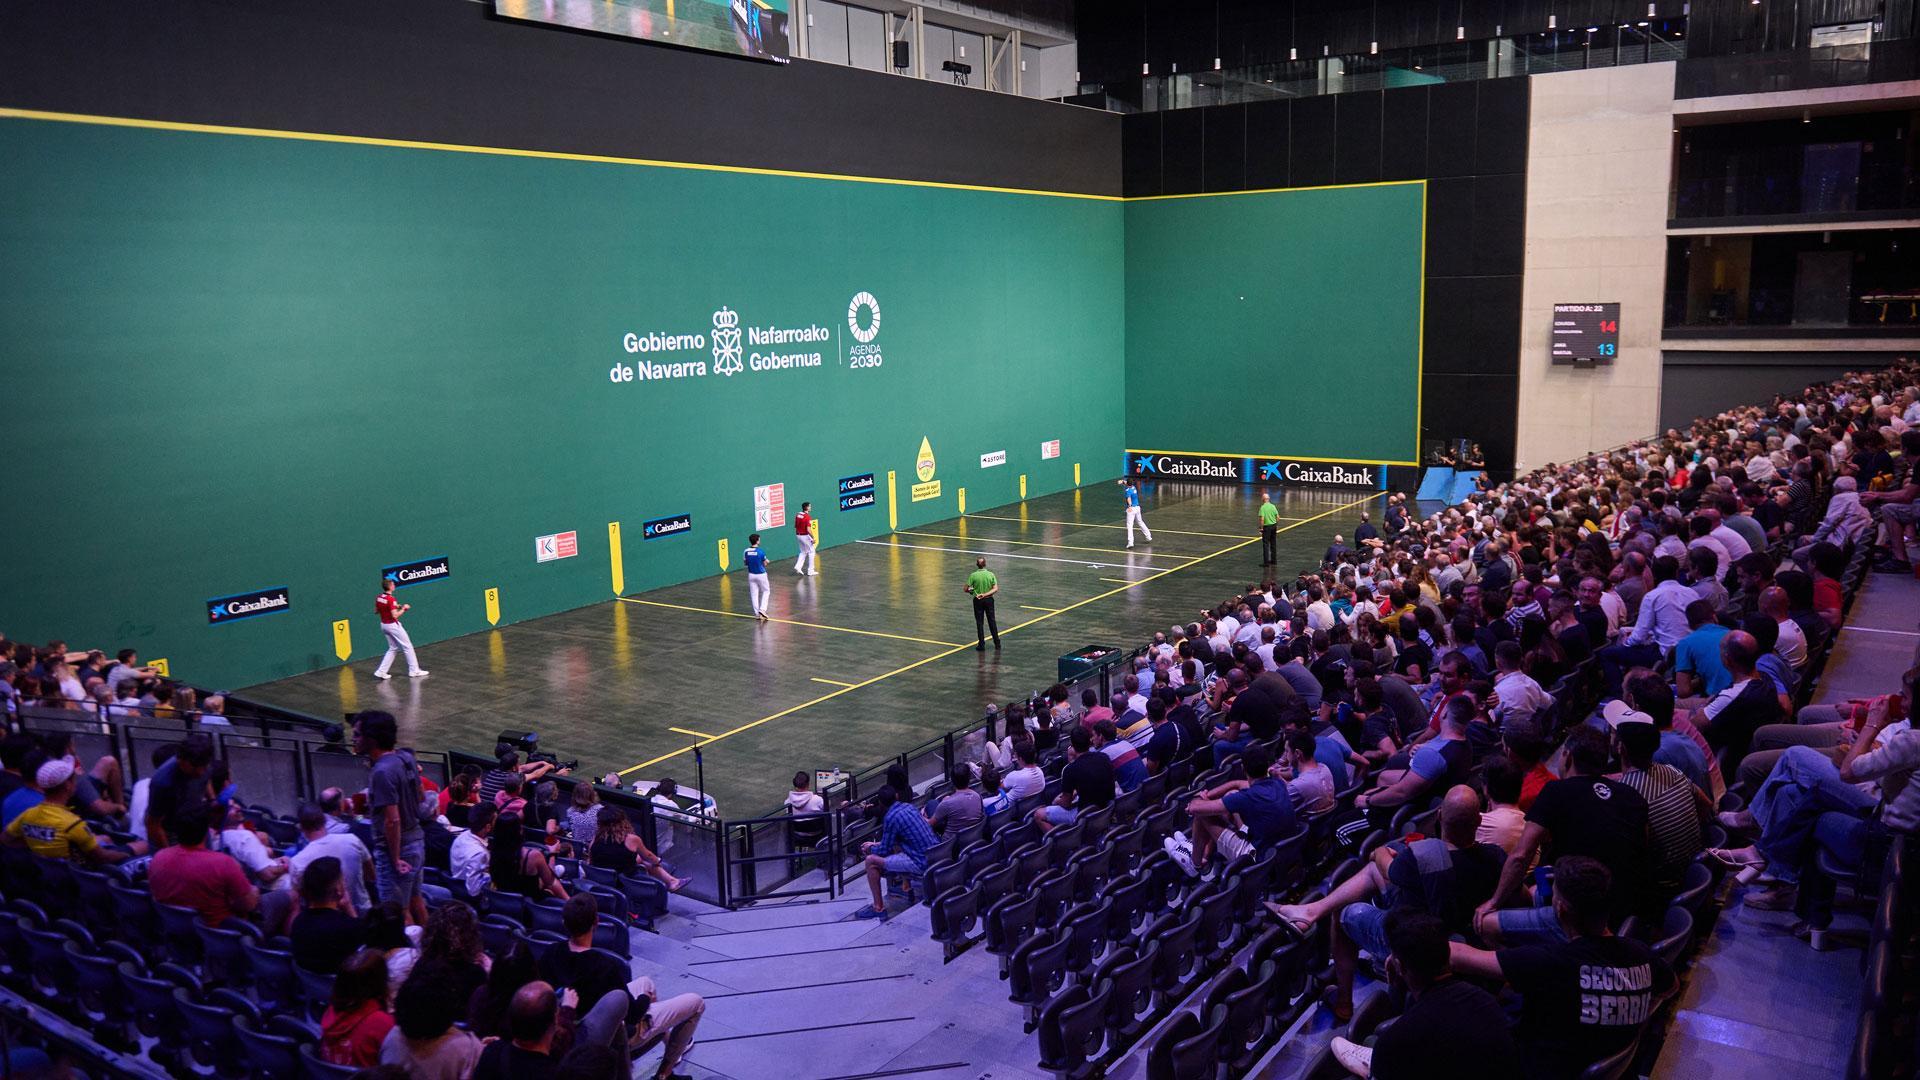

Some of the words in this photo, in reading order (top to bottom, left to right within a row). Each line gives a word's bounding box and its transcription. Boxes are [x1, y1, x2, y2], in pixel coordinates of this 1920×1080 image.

[1600, 320, 1617, 333] 14
[749, 324, 830, 345] Nafarroako
[623, 332, 705, 353] Gobierno
[849, 344, 882, 356] AGENDA
[1599, 343, 1615, 356] 13
[749, 352, 822, 371] Gobernua
[850, 354, 883, 369] 2030
[609, 364, 634, 383] de
[638, 360, 707, 381] Navarra
[1157, 456, 1238, 478] CaixaBank
[1284, 462, 1374, 486] CaixaBank
[847, 477, 873, 489] CaixaBank
[848, 494, 874, 507] CaixaBank
[611, 524, 617, 534] 7
[654, 518, 691, 534] CaixaBank
[811, 521, 817, 530] 5
[399, 562, 448, 582] CaixaBank
[488, 590, 496, 601] 8
[227, 594, 288, 614] CaixaBank
[337, 623, 345, 634] 9
